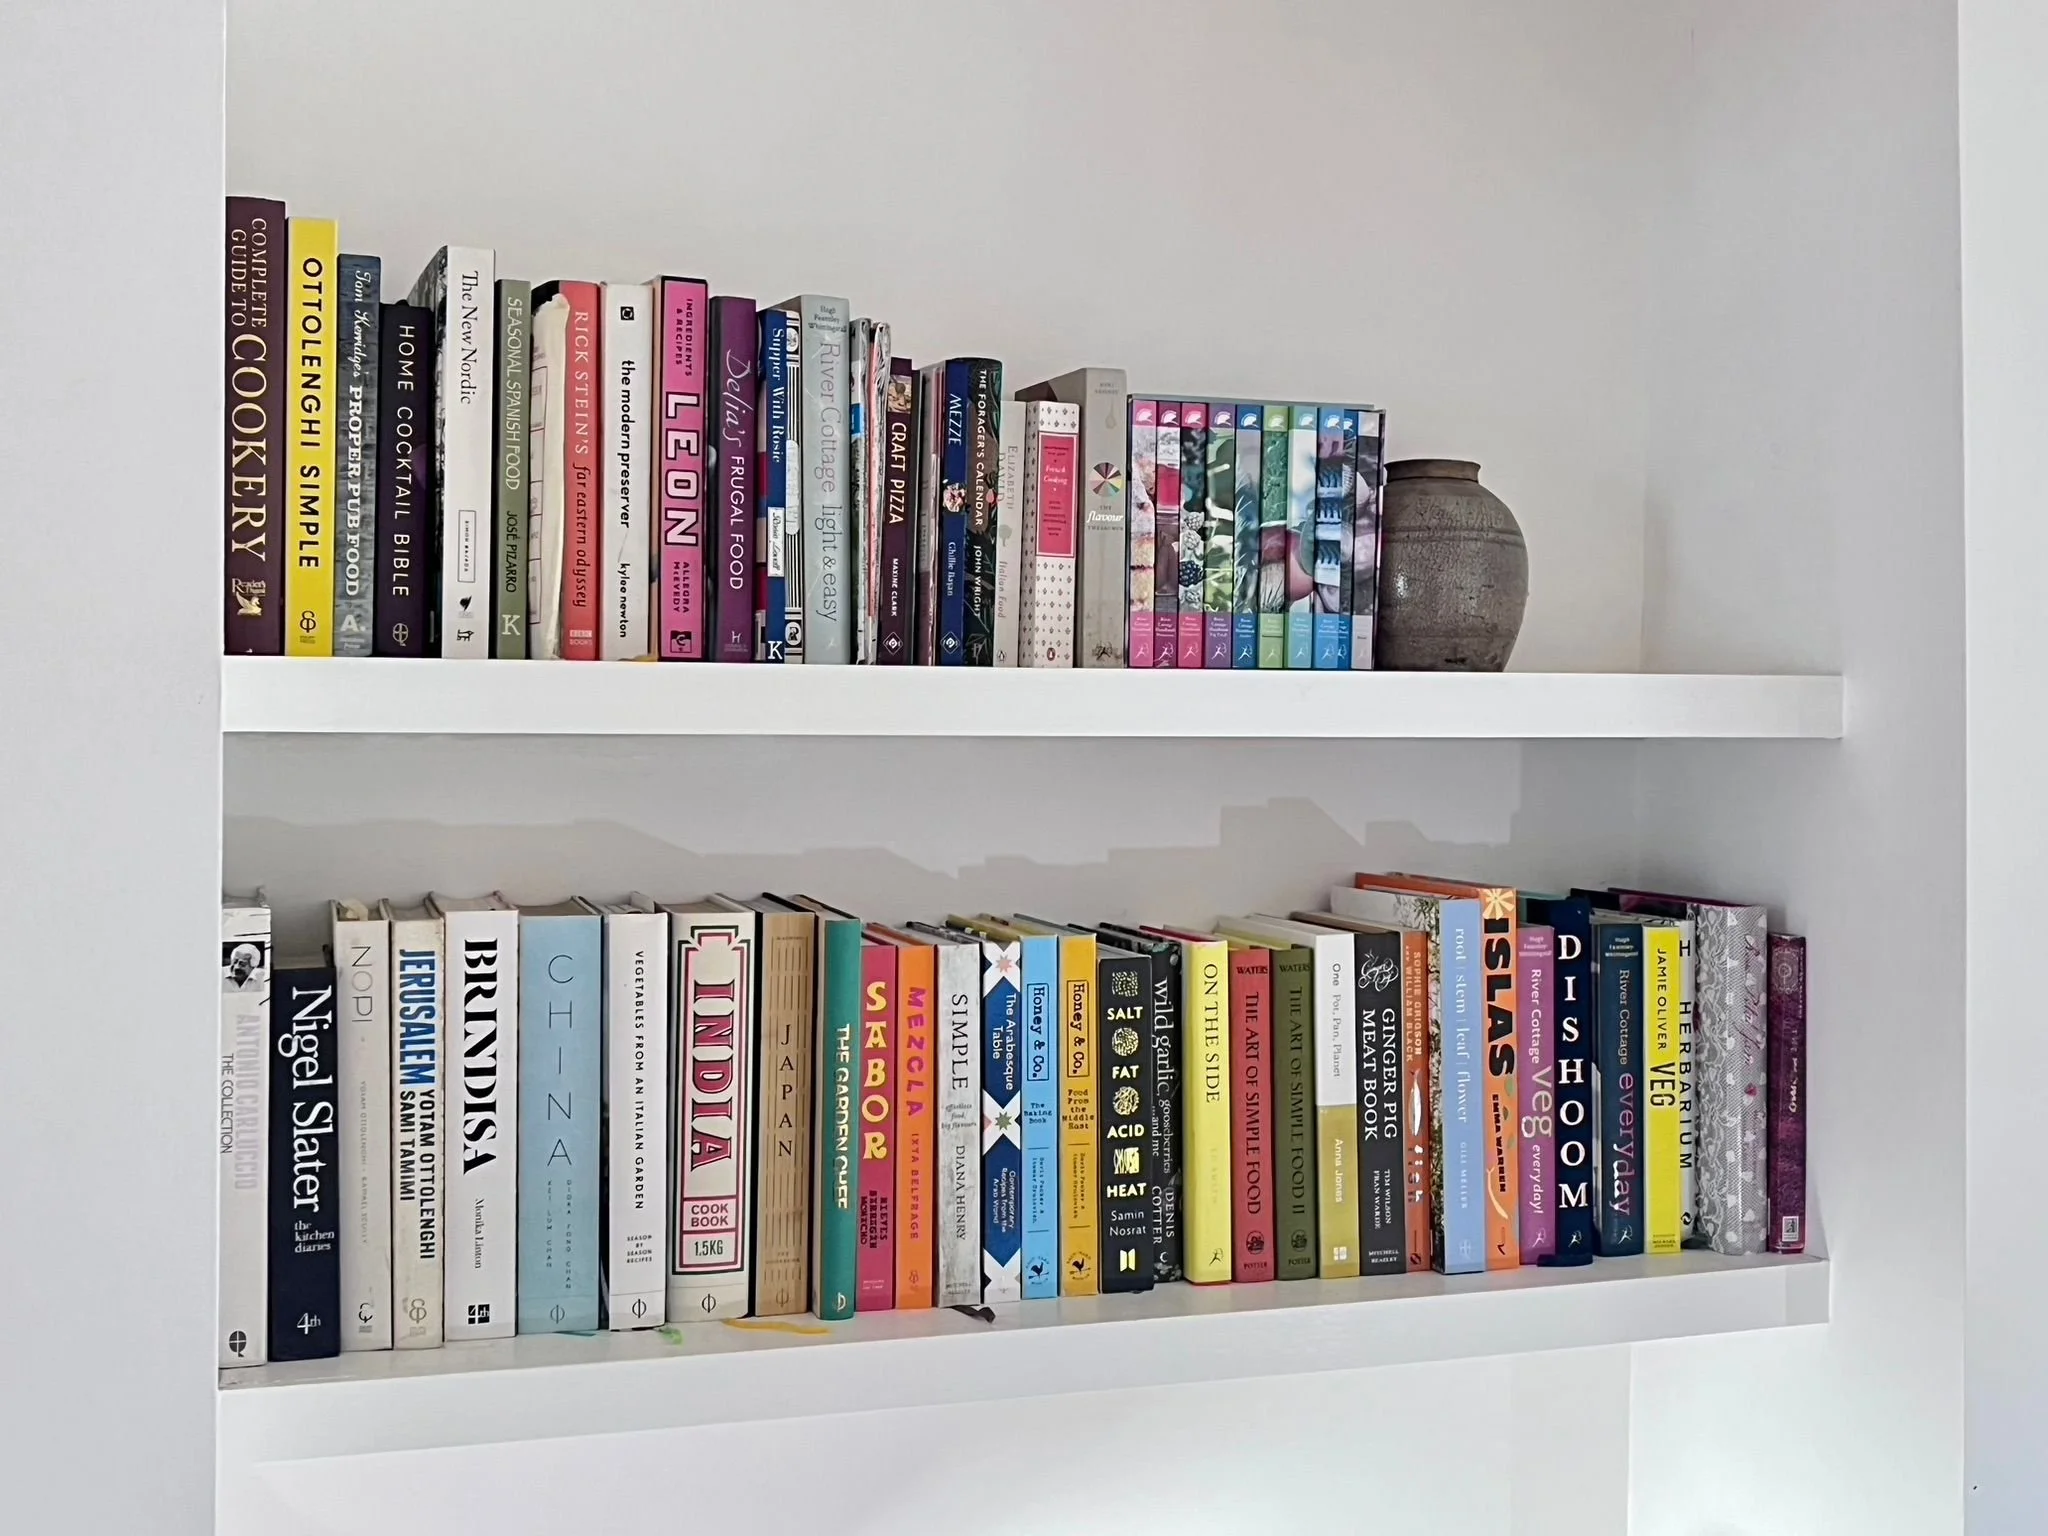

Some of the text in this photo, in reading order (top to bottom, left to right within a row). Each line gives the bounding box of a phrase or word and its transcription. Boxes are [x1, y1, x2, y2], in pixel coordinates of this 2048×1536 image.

[231, 229, 246, 326] GUIDE TO
[251, 218, 267, 327] COMPLETE
[351, 270, 371, 376] Tom Kerridge's
[460, 271, 479, 404] The New Nordic
[685, 298, 693, 376] INGREDIENTS
[299, 258, 323, 567] OTTOLENGHI SIMPLE
[505, 297, 522, 490] SEASONAL SPANISH FOOD
[574, 312, 589, 453] RICK STEIN'S
[769, 329, 785, 463] Supper With Rosie
[820, 343, 839, 402] River
[948, 394, 962, 445] MEZZE
[232, 334, 267, 561] COOKERY
[345, 385, 362, 595] PROPER PUB FOOD
[392, 326, 414, 595] HOME COCKTAIL BIBLE
[619, 360, 634, 528] the modern preserver
[665, 392, 699, 547] LEON
[722, 350, 753, 589] Delia's FRUGAL FOOD
[815, 408, 840, 492] Cottage
[889, 423, 906, 524] CRAFT PIZZA
[975, 370, 986, 525] THE FORAGER'S CALENDAR
[1006, 445, 1018, 510] ELIZABETH
[505, 511, 521, 592] JOSÉ PIZARRO
[572, 461, 591, 607] far eastern odyssey
[815, 505, 842, 551] light
[824, 556, 836, 568] &
[1086, 511, 1124, 522] flavour
[682, 562, 690, 613] ALLEGRA
[815, 573, 837, 621] easy
[973, 546, 982, 617] JOHN WRIGHT
[767, 641, 783, 659] K
[352, 946, 372, 1022] NOPI
[400, 949, 436, 1086] JERUSALEM
[1030, 987, 1045, 1077] Honey & Co.
[1071, 983, 1085, 1073] Honey & Co.
[1107, 1007, 1143, 1021] SALT
[1331, 963, 1342, 1077] One Pot, Pan, Planet
[1455, 928, 1470, 1123] root stem leaf flower
[1484, 917, 1514, 1076] ISLAS
[1529, 969, 1542, 1063] River Cottage
[1618, 970, 1630, 1065] River Cottage
[1657, 948, 1667, 1050] JAMIE OLIVER
[464, 939, 498, 1174] BRINDISA
[548, 955, 574, 1166] CHINA
[635, 951, 644, 1209] VEGETABLES FROM AN ITALIAN GARDEN
[691, 980, 735, 1171] INDIA
[861, 981, 889, 1159] SABOR
[907, 987, 926, 1116] MEZCLA
[951, 994, 968, 1090] SIMPLE
[992, 1026, 1003, 1059] Table
[1004, 993, 1016, 1090] The Arabesque
[1111, 1065, 1139, 1080] FAT
[1204, 964, 1220, 1103] ON THE SIDE
[1361, 1009, 1377, 1140] MEAT BOOK
[1381, 1008, 1397, 1139] GINGER PIG
[1558, 935, 1588, 1208] DISHOOM
[221, 1054, 233, 1153] THE COLLECTION
[235, 1014, 261, 1189] ANTONIO CARLUCCIO
[278, 986, 333, 1214] Nigel Slater
[779, 1025, 794, 1157] JAPAN
[1107, 1125, 1144, 1139] ACID
[1245, 992, 1261, 1214] THE ART OF SIMPLE FOOD
[1289, 987, 1305, 1214] THE ART OF SIMPLE FOOD II
[1520, 1065, 1552, 1138] veg
[1649, 1062, 1675, 1106] VEG
[1680, 1001, 1692, 1169] HERBARIUM
[400, 1091, 415, 1201] SAMI TAMIMI
[419, 1089, 435, 1259] YOTAM OTTOLENGHI
[1159, 1099, 1173, 1173] gooseberries
[1334, 1139, 1343, 1202] Anna Jones
[1496, 1136, 1506, 1192] WARREN
[475, 1198, 485, 1268] Monika Linton
[691, 1203, 729, 1215] COOK
[691, 1215, 729, 1227] BOOK
[910, 1133, 919, 1239] IXTA BELFRAGE
[955, 1146, 967, 1240] DIANA HENRY
[1106, 1185, 1147, 1199] HEAT
[1109, 1227, 1146, 1237] Nosrat
[1111, 1211, 1144, 1221] Samin
[1152, 1186, 1163, 1244] COTTER
[1165, 1192, 1175, 1237] DENIS
[295, 1230, 334, 1241] kitchen
[295, 1243, 331, 1253] diaries
[694, 1240, 724, 1256] 1.5KG
